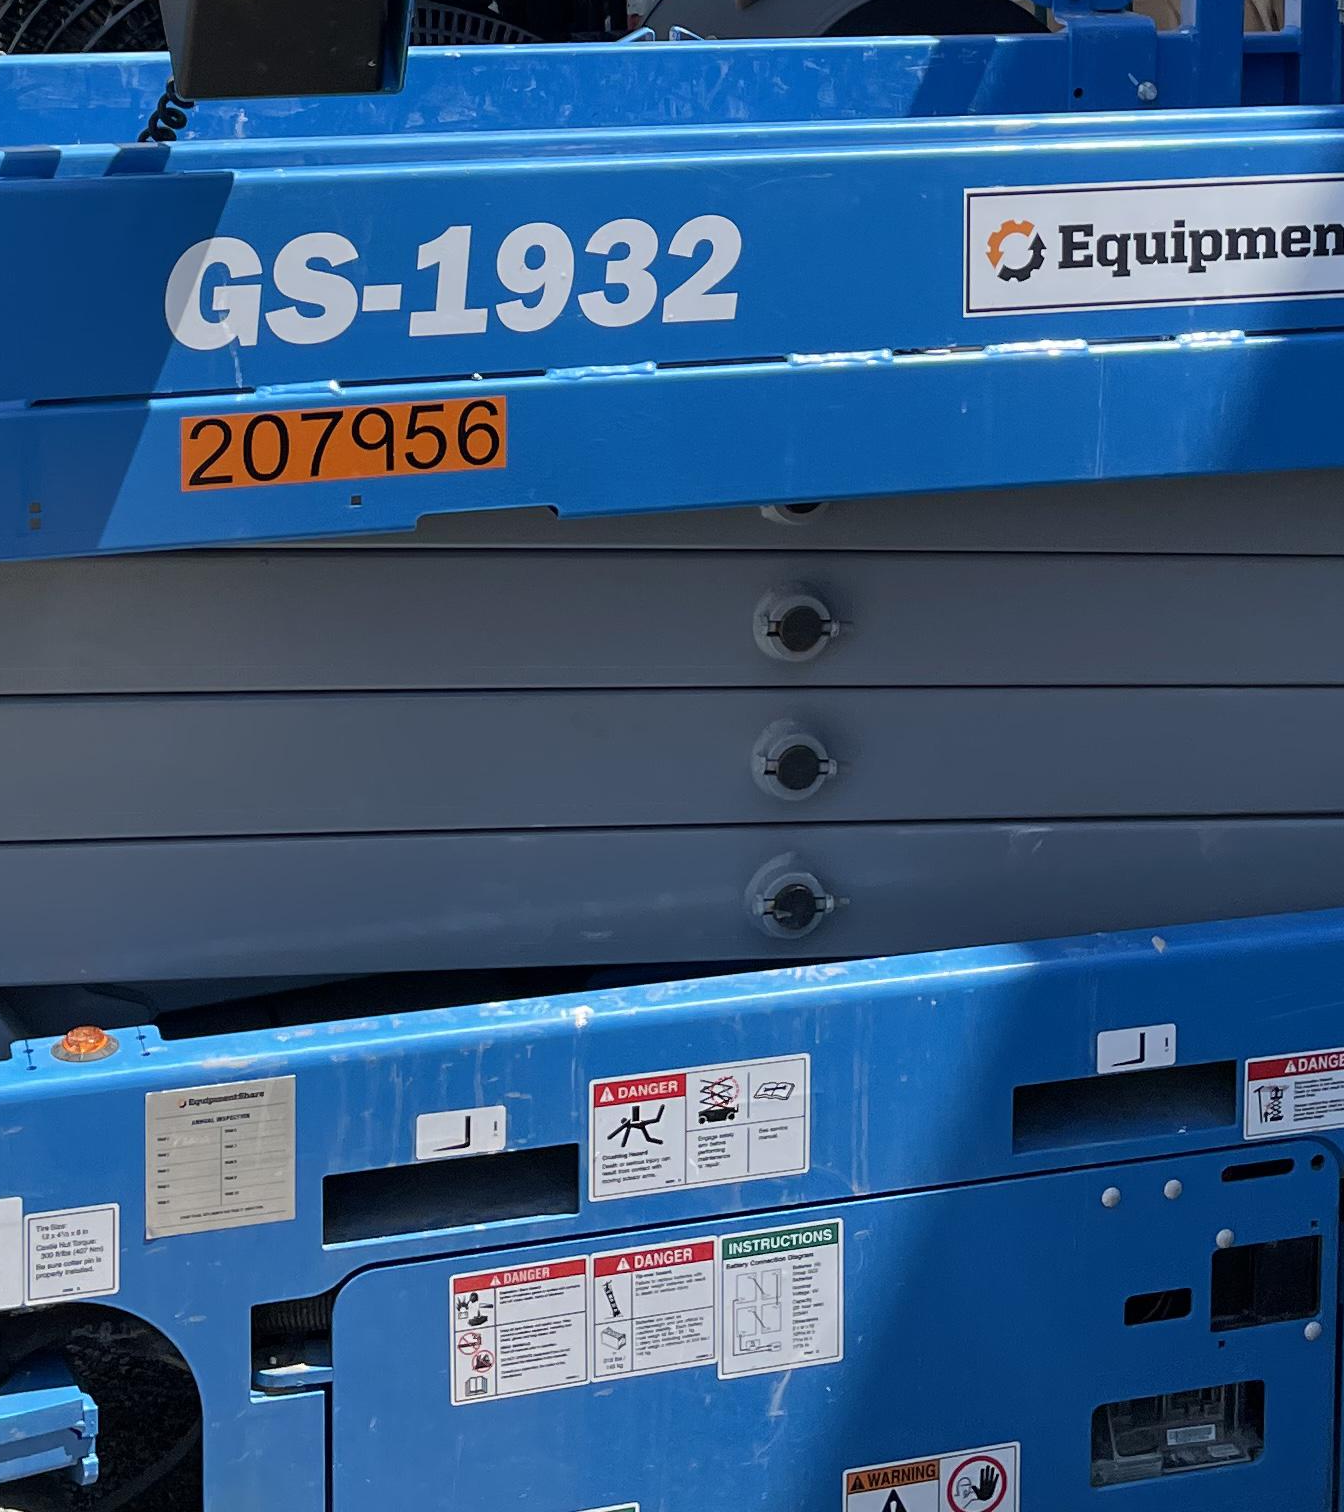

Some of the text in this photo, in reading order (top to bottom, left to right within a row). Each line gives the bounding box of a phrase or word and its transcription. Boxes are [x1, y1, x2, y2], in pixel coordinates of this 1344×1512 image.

[164, 214, 742, 351] GS-1932
[188, 398, 501, 486] 207956
[188, 1091, 265, 1106] EquipmentShare
[618, 1079, 679, 1100] DANGER
[728, 1228, 833, 1255] INSTRUCTIONS
[634, 1247, 693, 1269] DANGER
[503, 1266, 550, 1284] DANGER
[867, 1463, 936, 1487] WARNING
